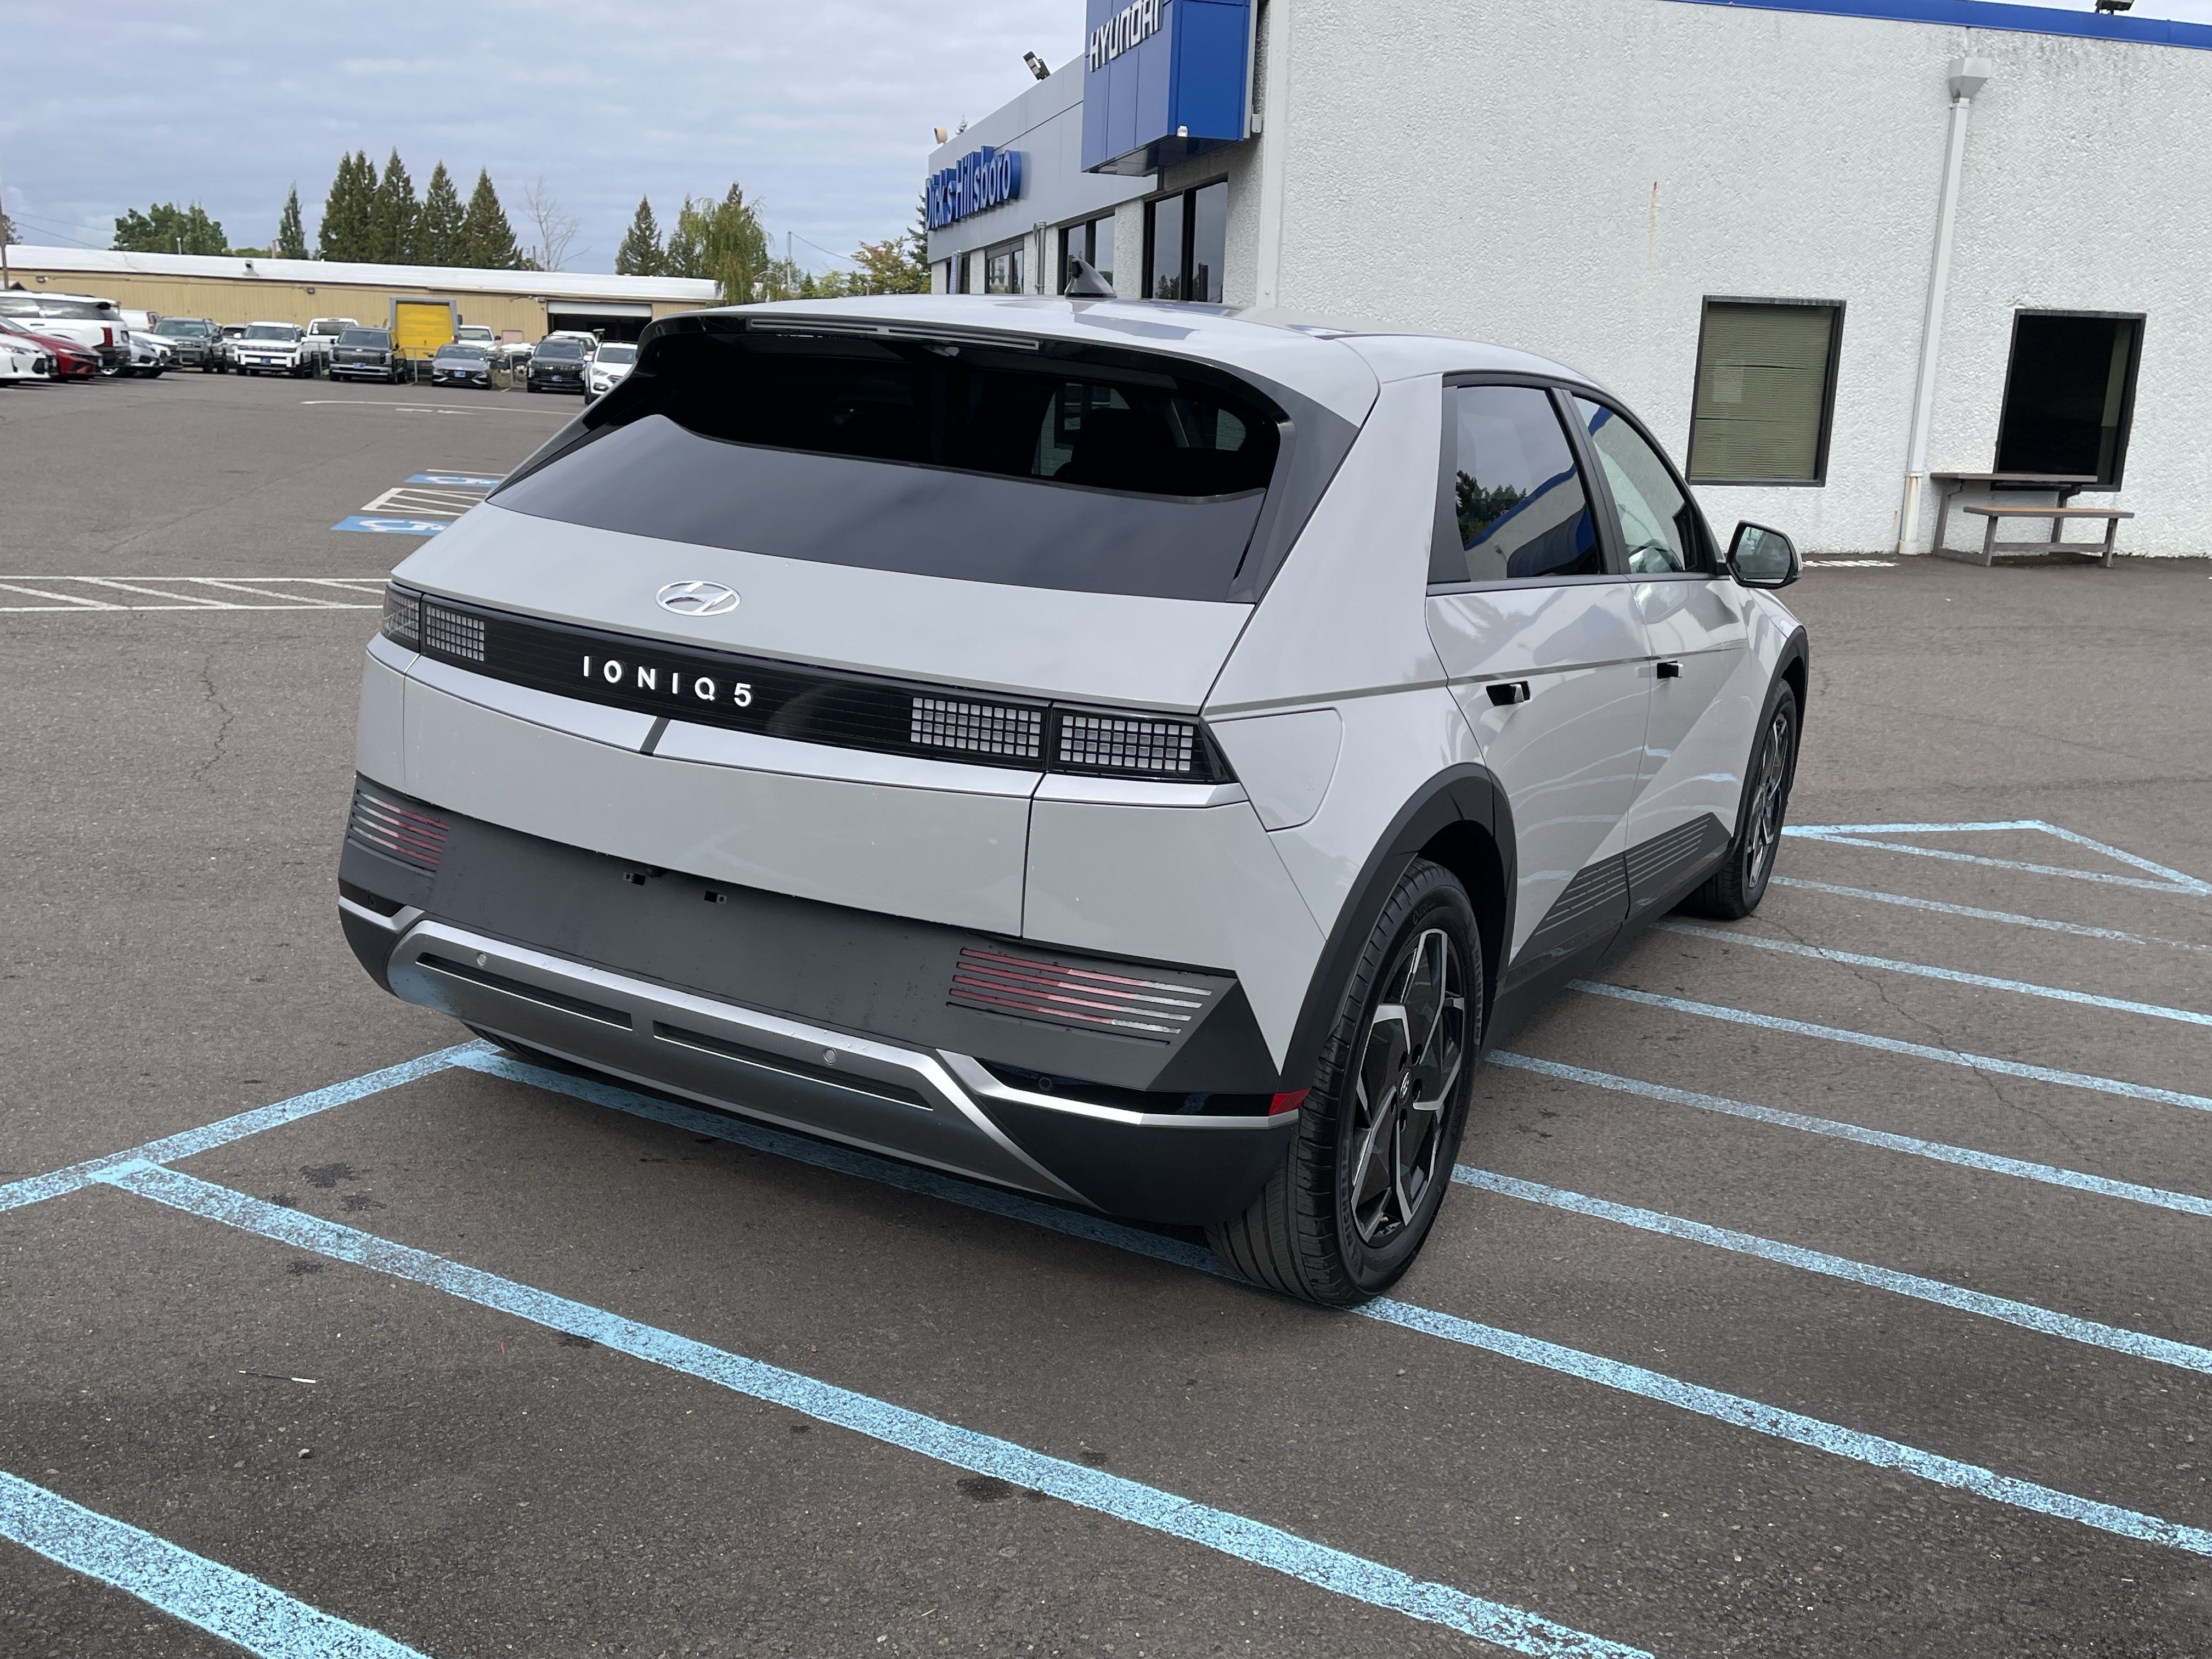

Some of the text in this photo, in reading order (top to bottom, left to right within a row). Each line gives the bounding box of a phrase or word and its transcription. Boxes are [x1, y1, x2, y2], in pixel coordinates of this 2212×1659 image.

[1090, 0, 1159, 72] HYUNDAI
[926, 145, 1013, 230] Dick's Hillsboro
[583, 656, 752, 707] IONIQ 5
[1474, 949, 1483, 1039] MICHELIN
[1342, 1146, 1354, 1247] MICHELIN
